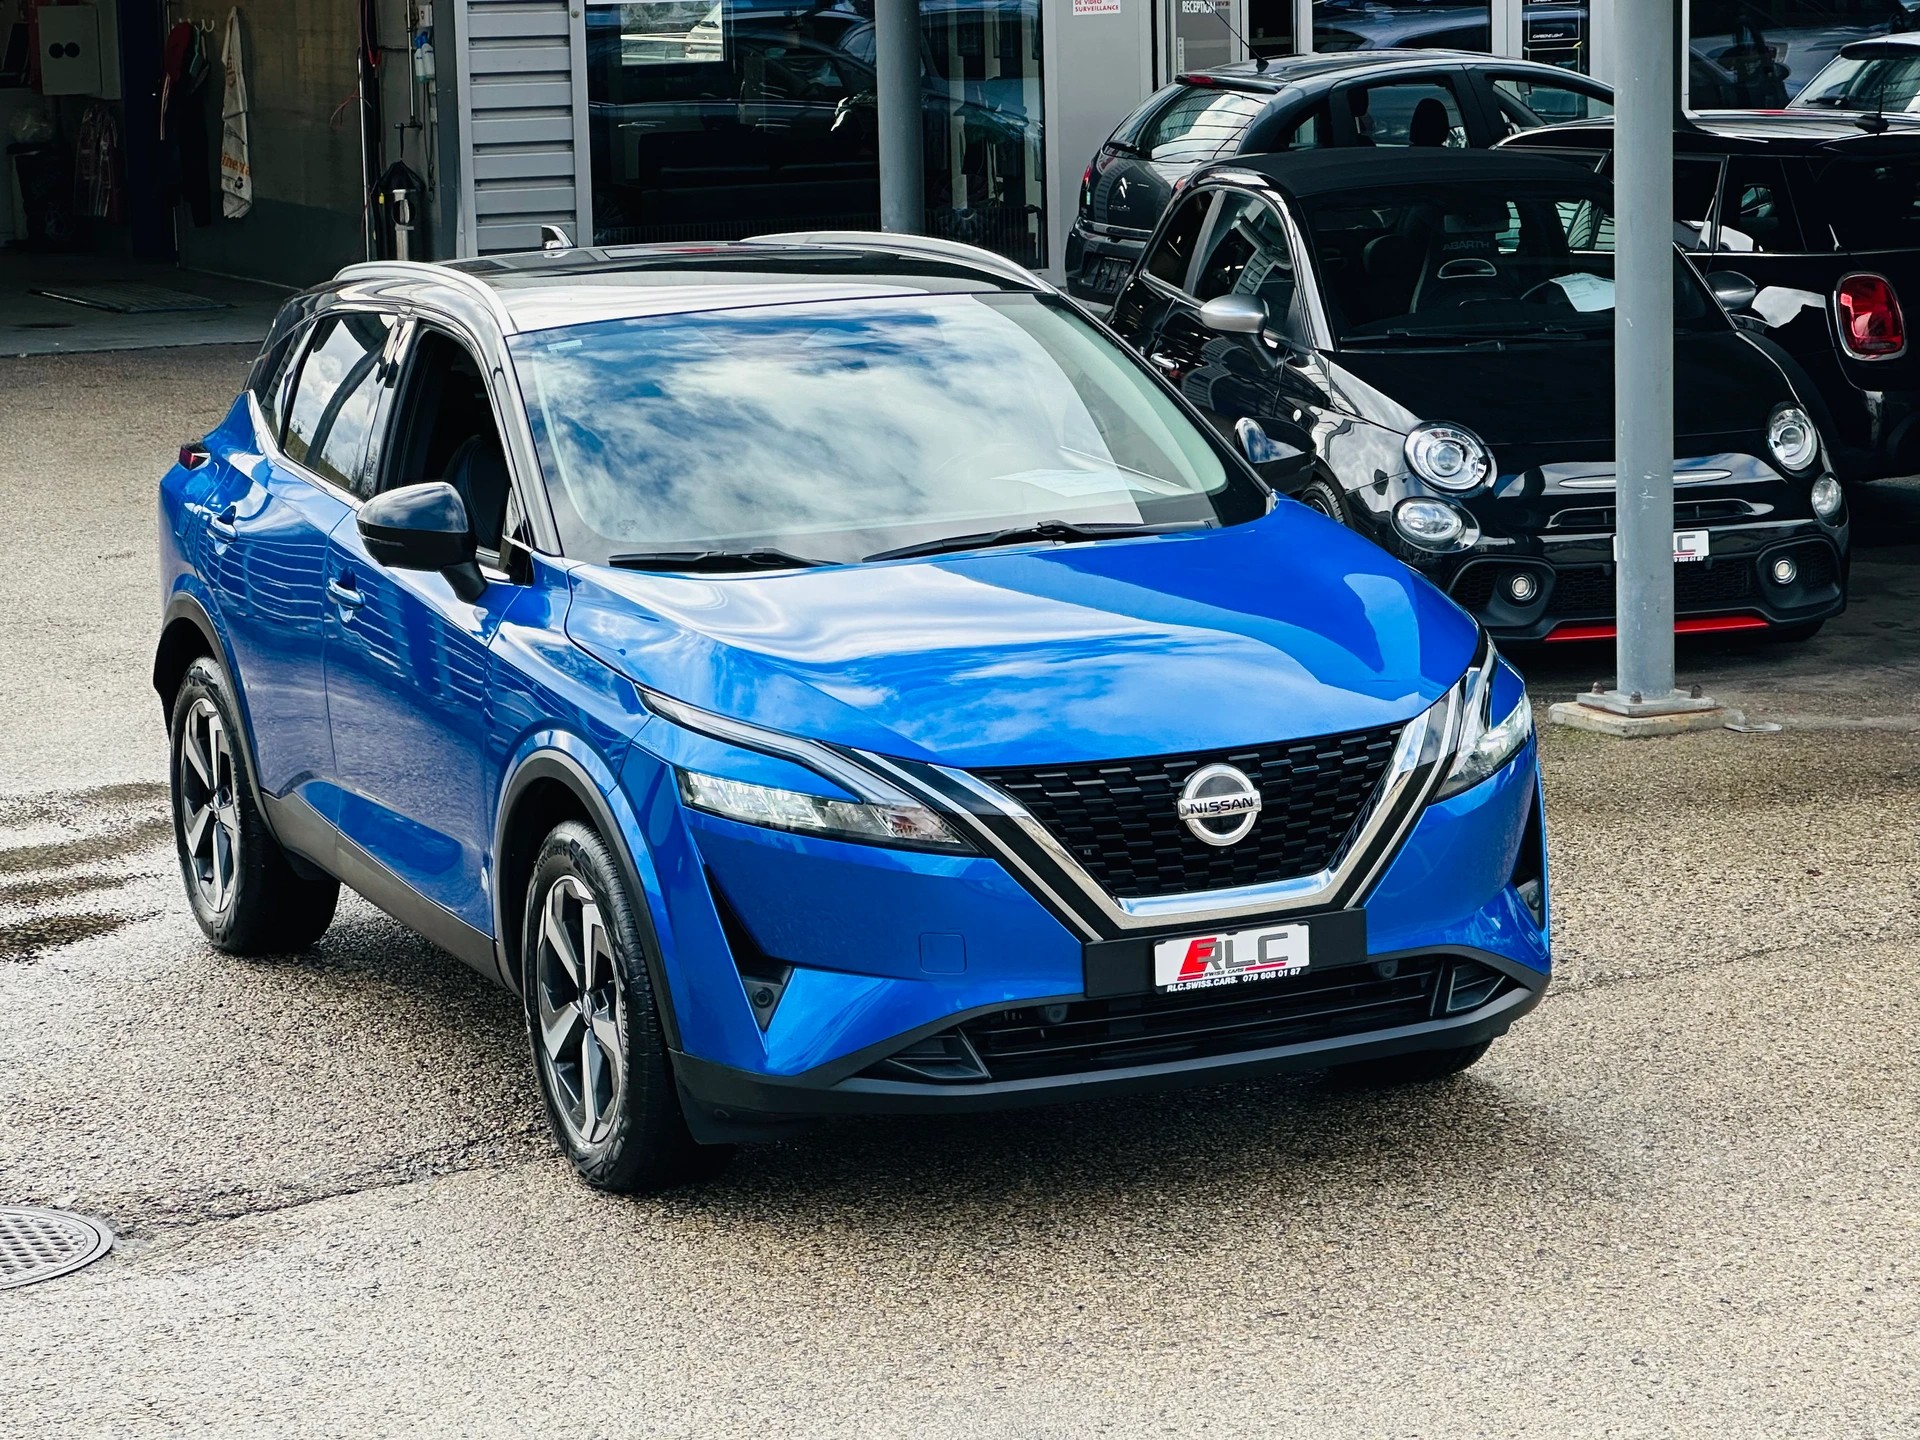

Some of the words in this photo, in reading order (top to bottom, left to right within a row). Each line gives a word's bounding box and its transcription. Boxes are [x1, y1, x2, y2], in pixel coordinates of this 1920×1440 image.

[1189, 796, 1254, 814] NISSAN
[1187, 932, 1289, 972] RLC
[1166, 977, 1239, 993] RLC.SWISS.CARS.
[1242, 974, 1259, 983] 079
[1260, 971, 1277, 980] 608
[1277, 970, 1288, 978] 01
[1290, 967, 1302, 976] 87
[1203, 969, 1226, 978] SWISS
[1227, 967, 1245, 975] CARS
